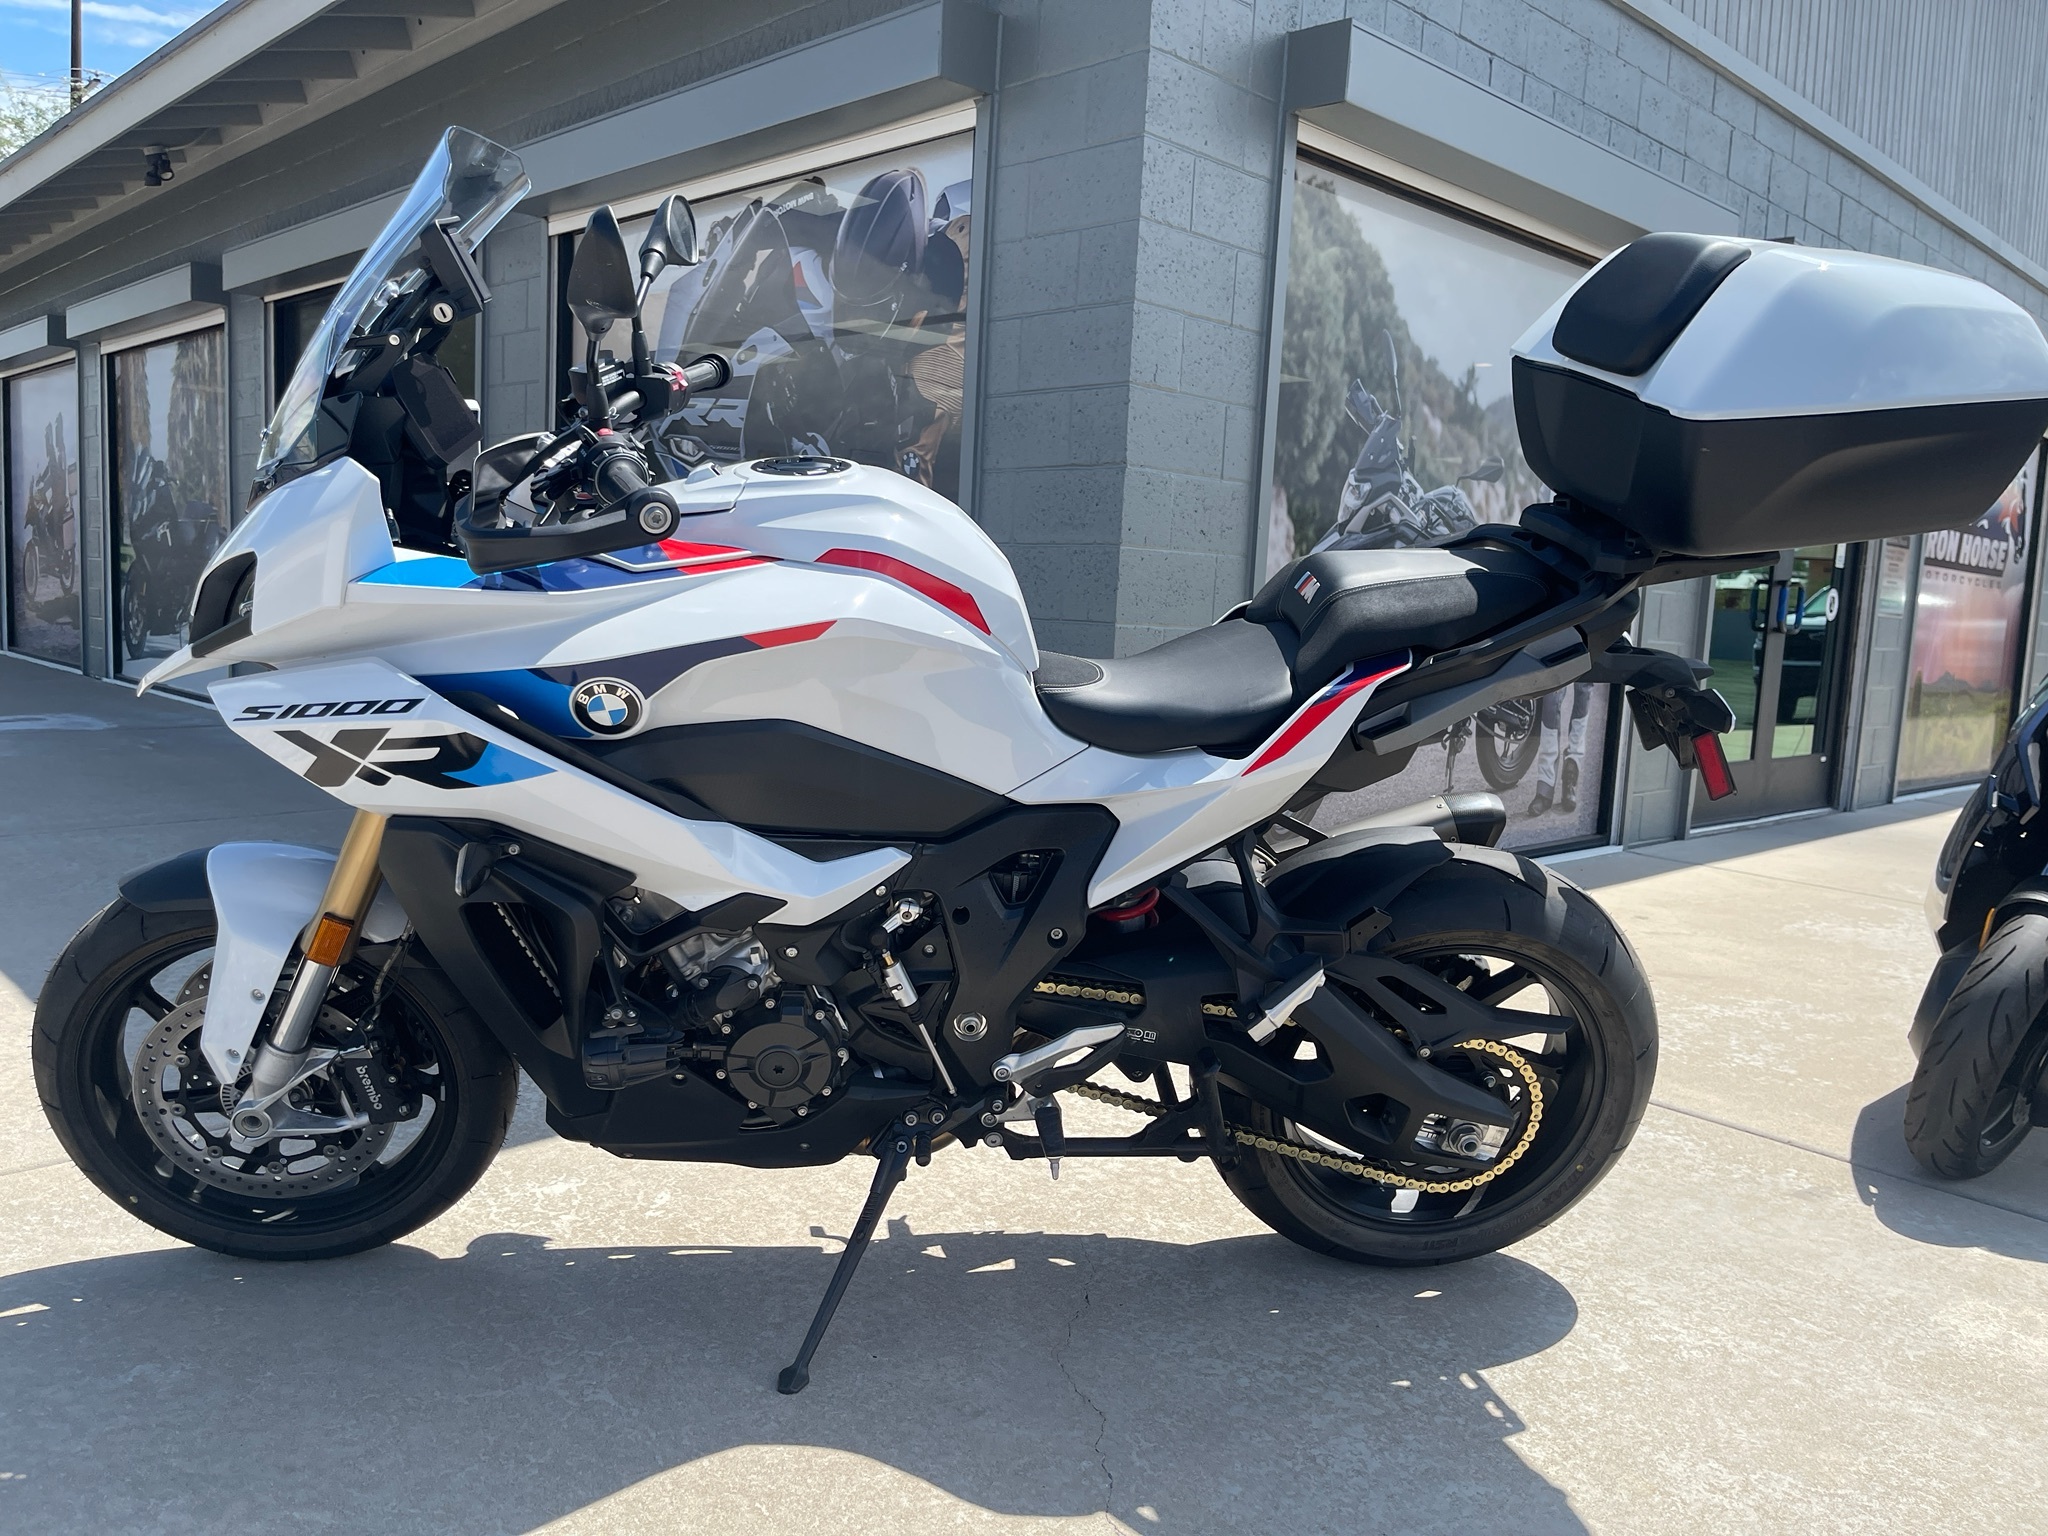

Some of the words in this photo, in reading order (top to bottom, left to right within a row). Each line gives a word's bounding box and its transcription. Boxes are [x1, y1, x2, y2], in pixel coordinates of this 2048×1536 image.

[1924, 530, 1960, 563] RON
[1958, 533, 2008, 571] HORSE
[1925, 570, 2003, 590] OTORCYCLES
[577, 684, 630, 705] BMW
[233, 698, 425, 722] S1000
[355, 1065, 383, 1110] brembo
